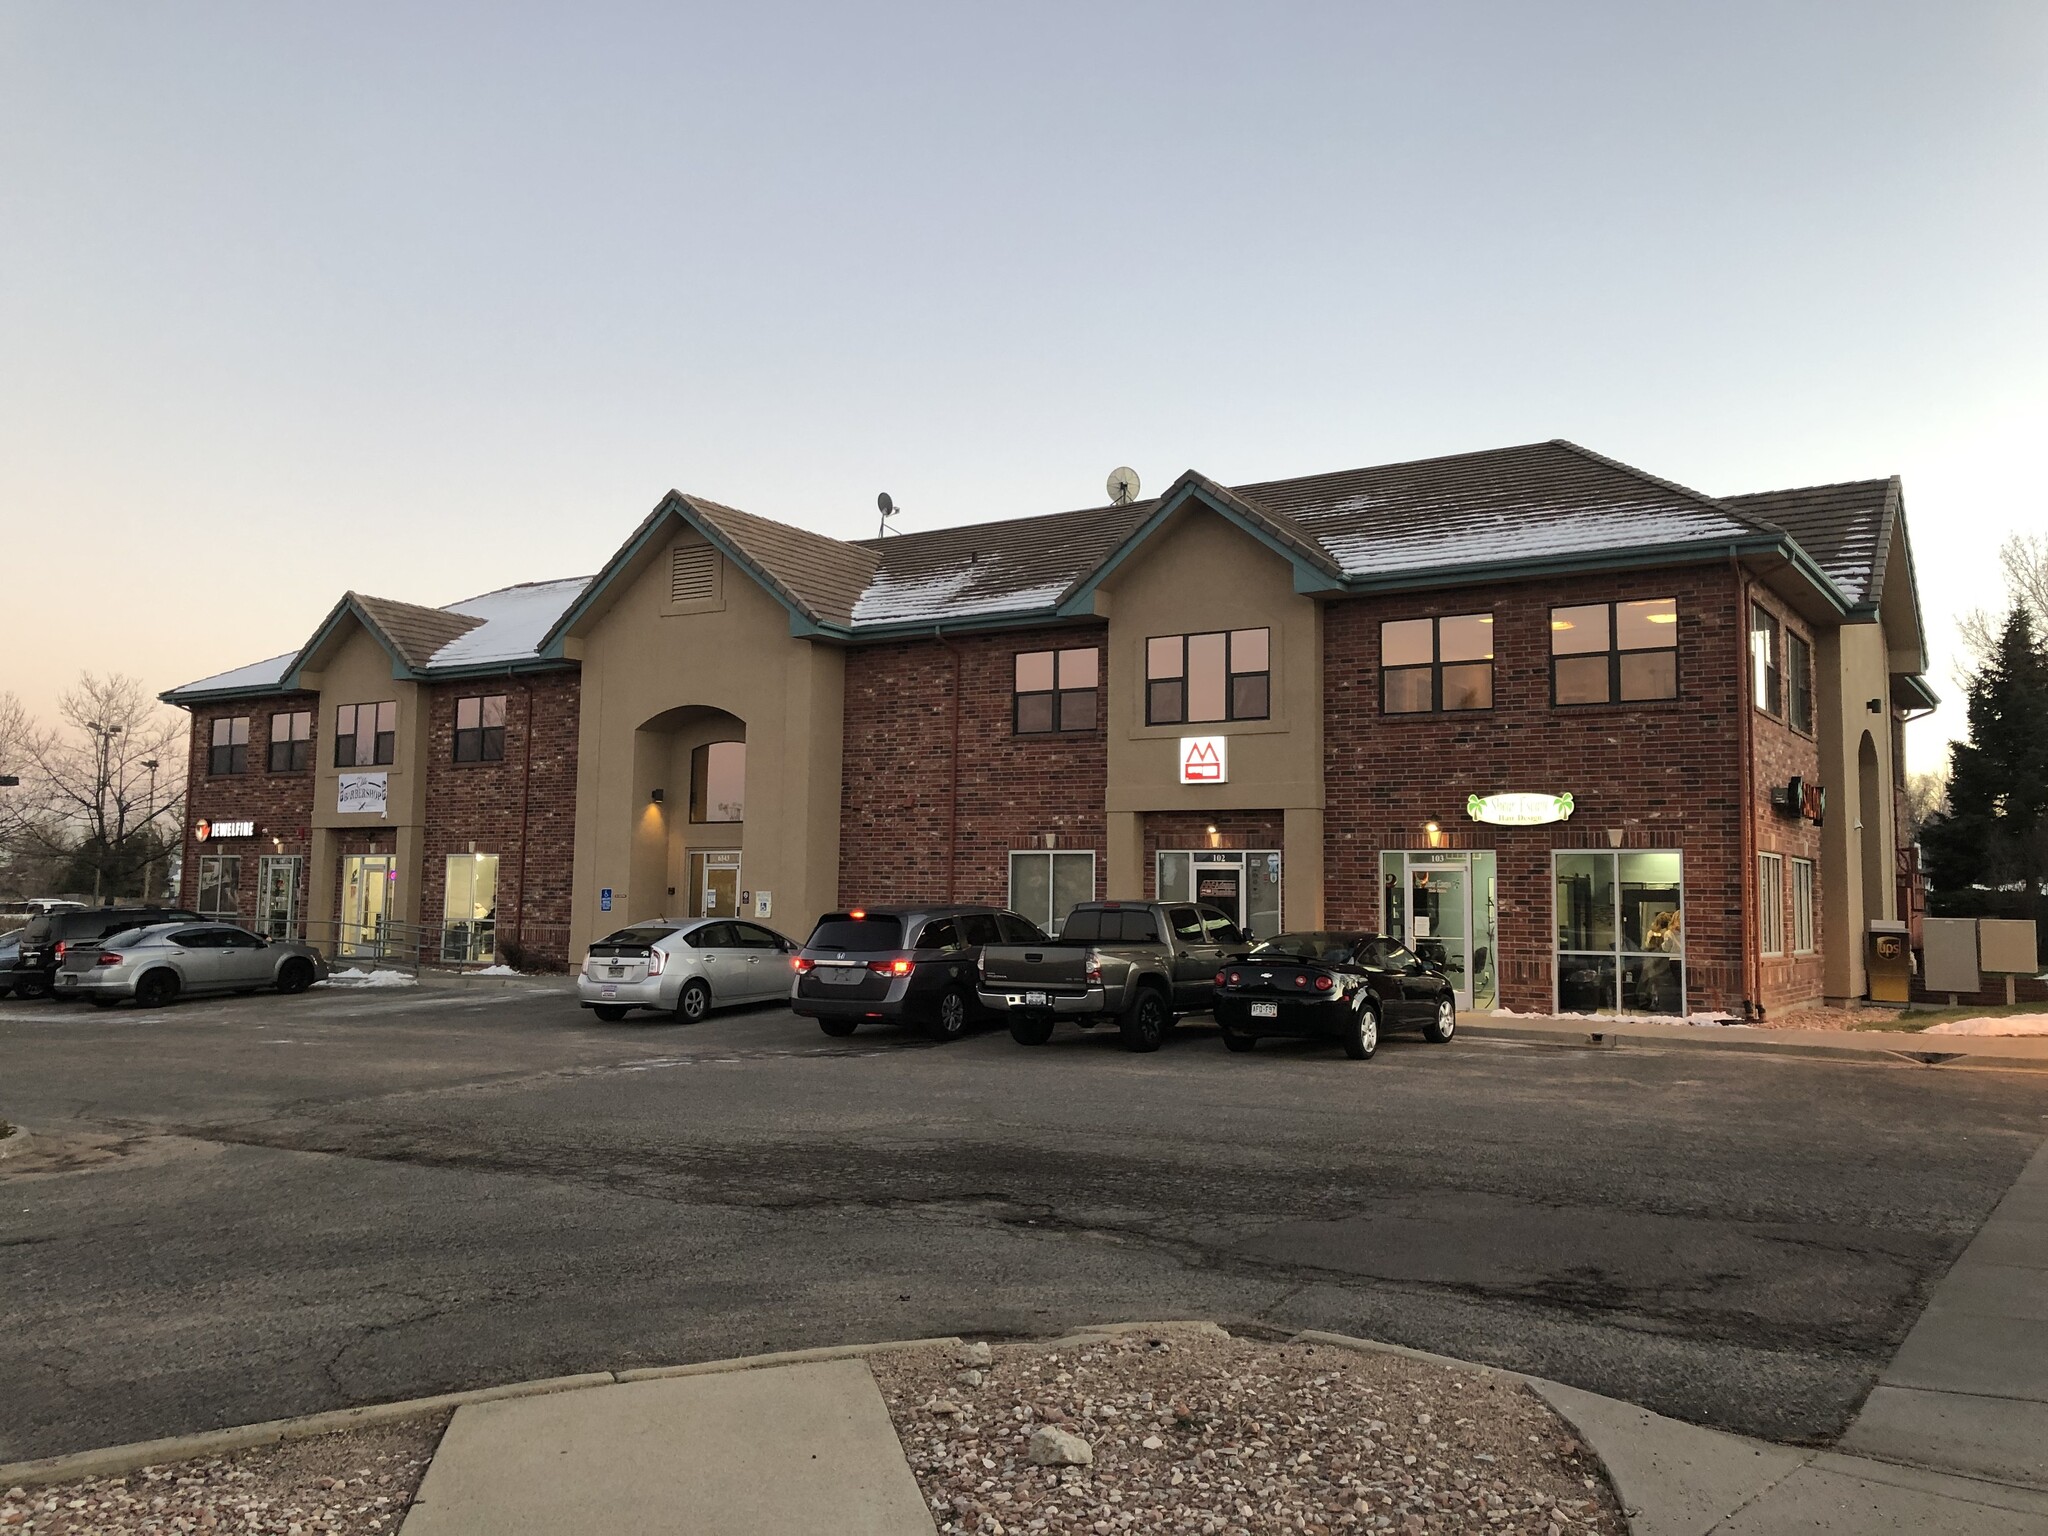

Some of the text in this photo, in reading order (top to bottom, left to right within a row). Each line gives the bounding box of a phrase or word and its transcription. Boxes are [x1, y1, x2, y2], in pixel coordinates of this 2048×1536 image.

[344, 788, 382, 801] BARBERSHOP
[1498, 814, 1543, 822] Hair Design
[211, 821, 254, 837] JEWELFIRE
[1213, 854, 1226, 862] 102
[1431, 854, 1445, 863] 103
[1880, 943, 1899, 957] ups
